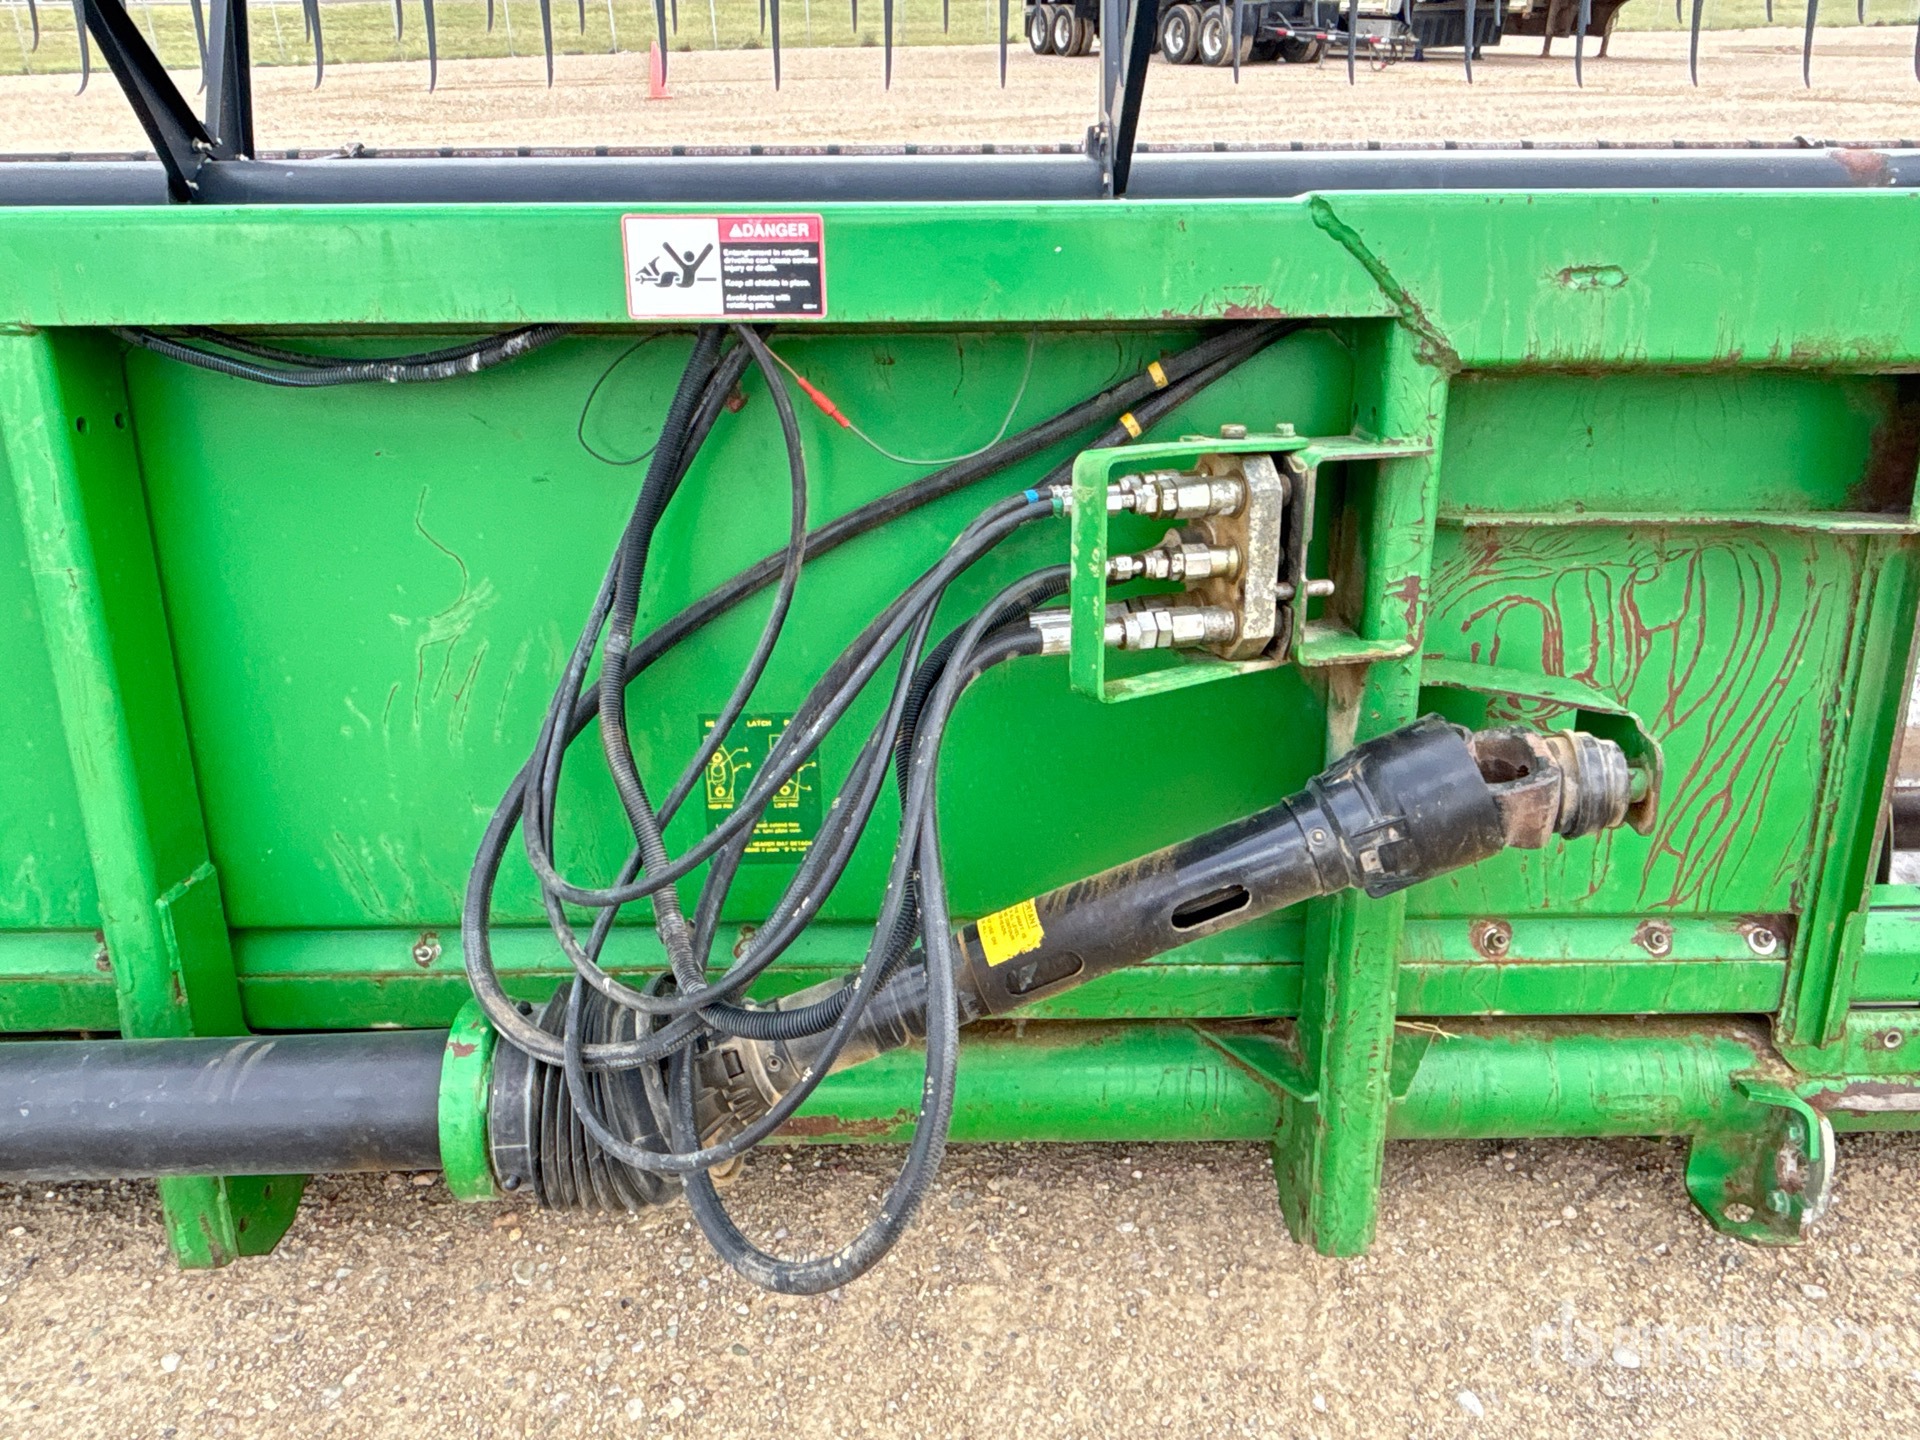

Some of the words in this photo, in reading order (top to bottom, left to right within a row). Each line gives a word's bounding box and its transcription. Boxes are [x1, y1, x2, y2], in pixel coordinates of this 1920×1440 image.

[742, 223, 809, 238] DANGER
[781, 249, 809, 258] rotating
[724, 265, 745, 273] injury
[724, 279, 744, 288] Keep
[744, 279, 754, 287] all
[754, 279, 780, 287] shields
[781, 279, 789, 287] in
[726, 302, 754, 310] rotating
[755, 302, 775, 310] parts.
[746, 720, 772, 728] LATCH
